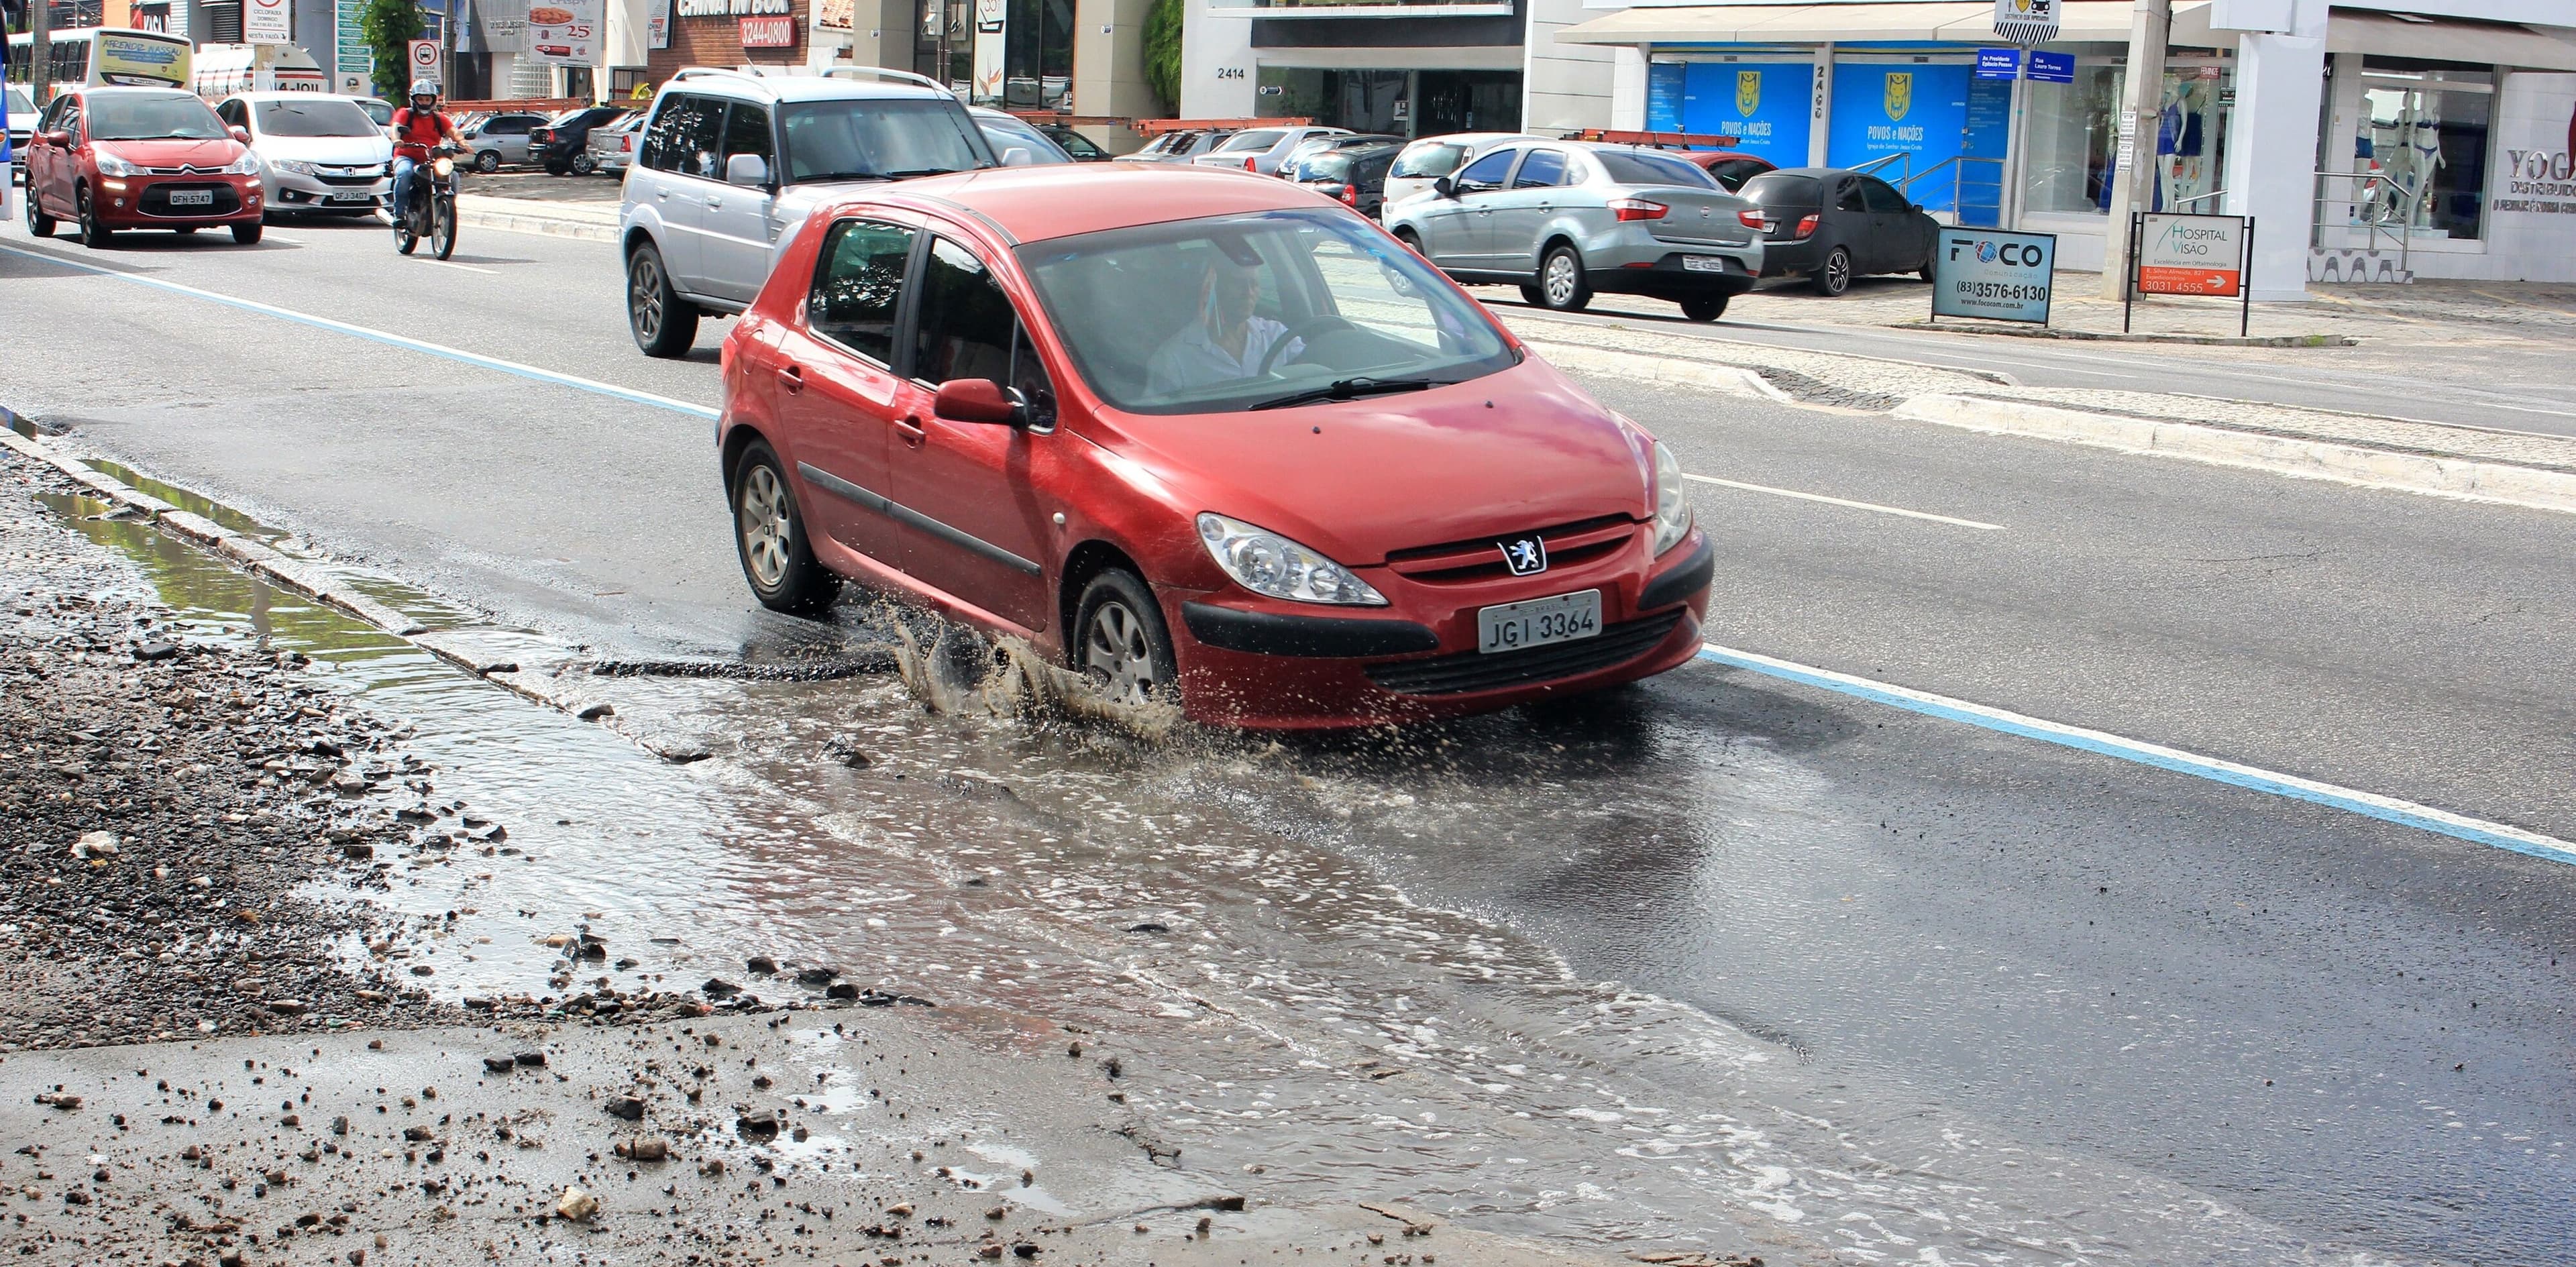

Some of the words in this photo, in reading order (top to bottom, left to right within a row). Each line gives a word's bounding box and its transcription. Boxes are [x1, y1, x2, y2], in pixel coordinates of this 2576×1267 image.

[566, 25, 590, 38] 25
[741, 21, 790, 44] 3244-0800
[1218, 68, 1244, 79] 2414
[1721, 121, 1742, 135] POVOS
[1743, 125, 1748, 135] e
[1748, 121, 1772, 137] NAÇÕES
[1868, 126, 1890, 140] POVOS
[1892, 130, 1897, 140] e
[1898, 125, 1923, 142] NAÇÕES
[2507, 150, 2576, 180] YOG
[2172, 225, 2228, 241] HOSPITAL
[1950, 239, 2043, 268] FOCO
[2172, 241, 2208, 255] VISÃO
[1984, 269, 2038, 279] Comunicação
[2145, 281, 2203, 292] 3031.4555
[1961, 298, 2024, 309] www.fococom.com.br
